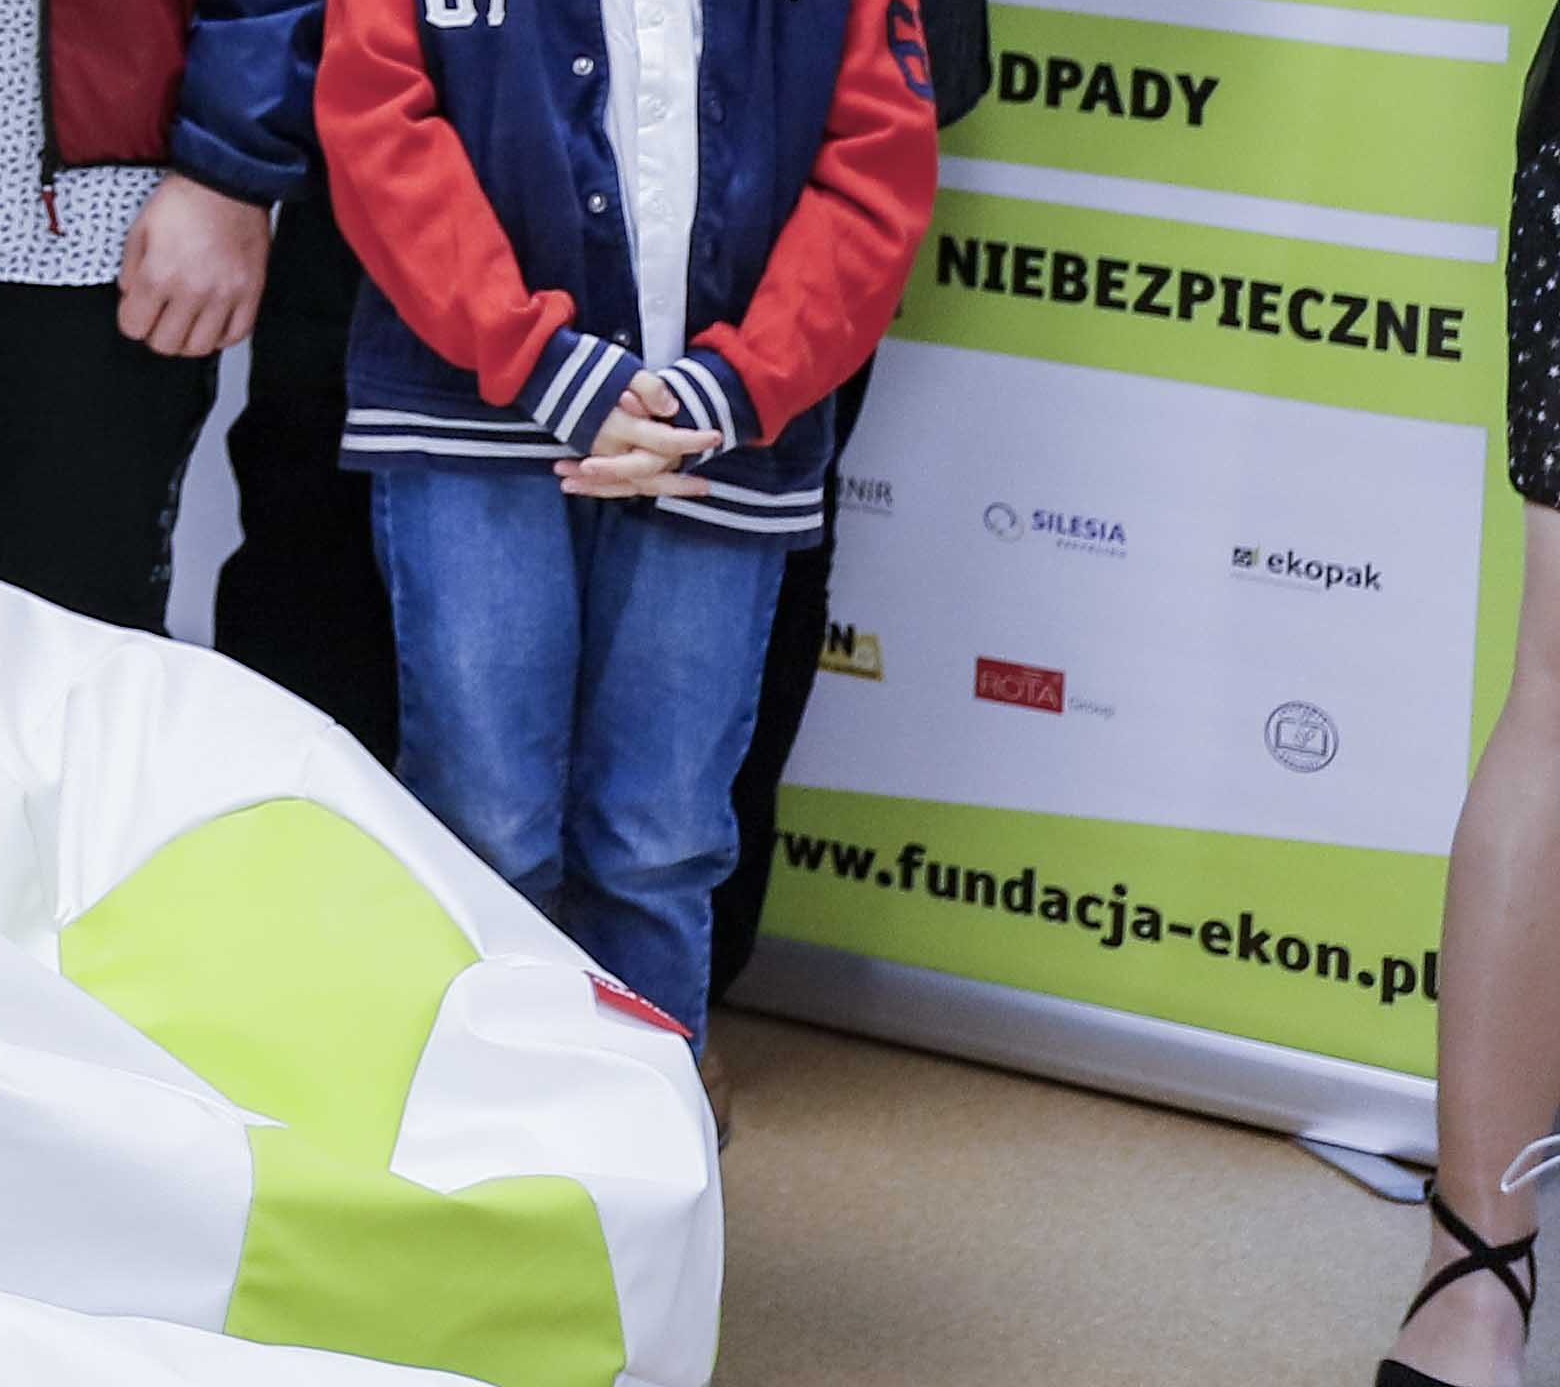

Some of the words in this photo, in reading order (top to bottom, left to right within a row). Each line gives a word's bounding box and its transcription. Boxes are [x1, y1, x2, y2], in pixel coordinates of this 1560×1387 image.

[988, 50, 1220, 126] DPADY
[936, 234, 1465, 362] NIEBEZPIECZNE
[1031, 509, 1127, 544] SILESIA
[1267, 549, 1383, 591] ekopak
[979, 673, 1059, 709] ROTA
[775, 830, 1440, 1003] ww.fundacja-ekon.pl
